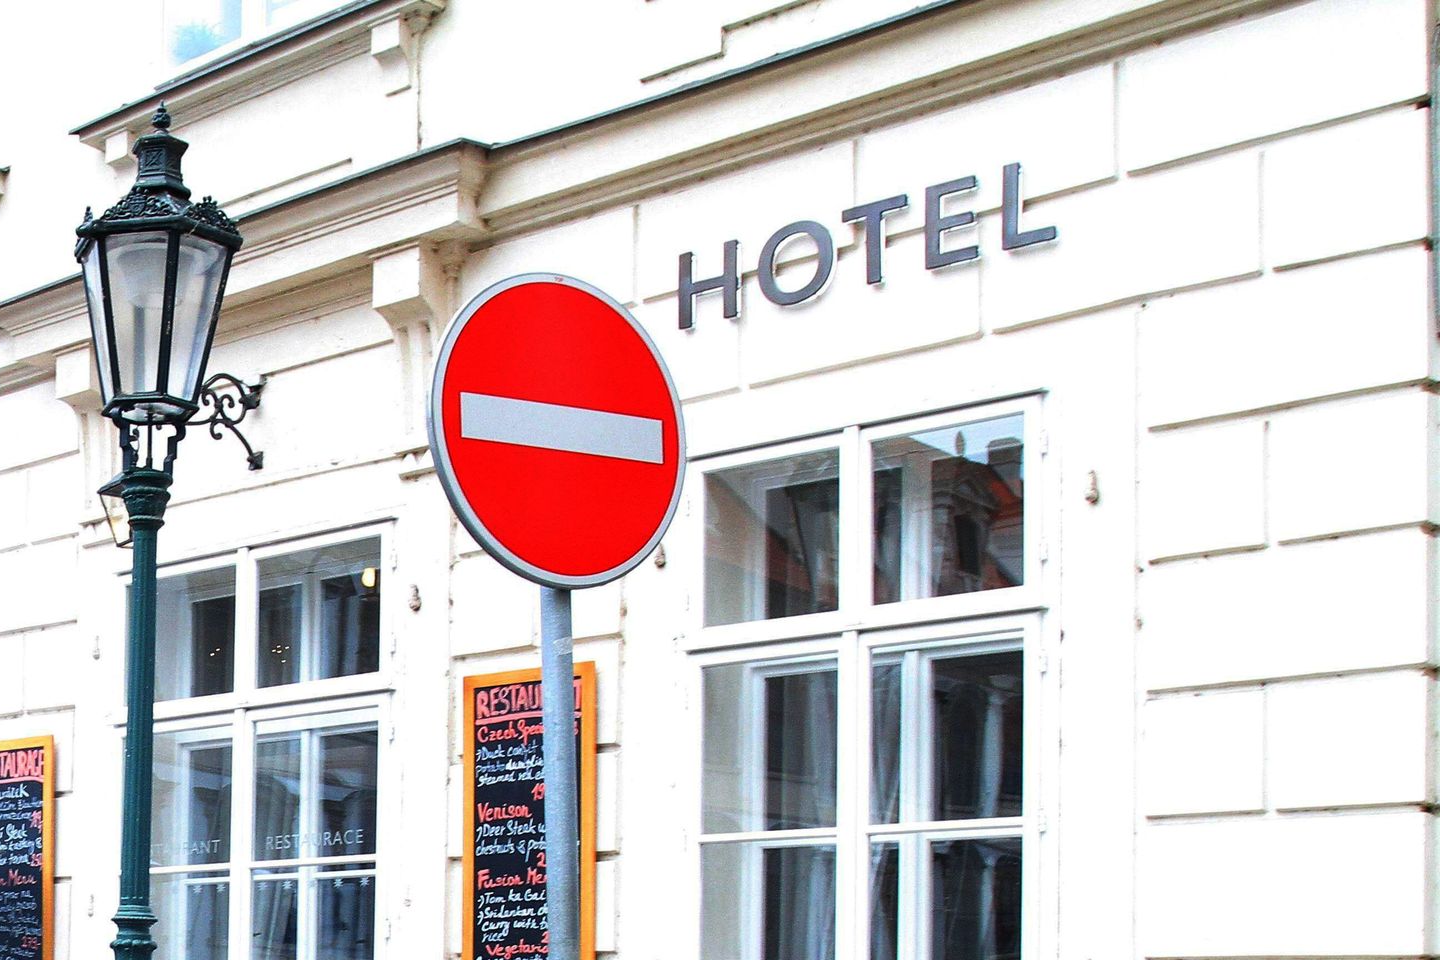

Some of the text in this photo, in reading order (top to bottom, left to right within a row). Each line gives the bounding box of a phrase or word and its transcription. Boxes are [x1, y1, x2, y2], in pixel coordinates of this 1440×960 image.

[678, 161, 1057, 330] HOTEL
[476, 679, 582, 719] RESTAUT
[477, 720, 518, 743] Czech
[477, 802, 532, 823] Venison
[506, 817, 536, 836] Steak
[266, 828, 364, 851] RESTAURACE
[477, 868, 524, 891] Fusion
[484, 891, 506, 904] Tom
[513, 917, 539, 929] with
[485, 938, 549, 960] Vegetaria
